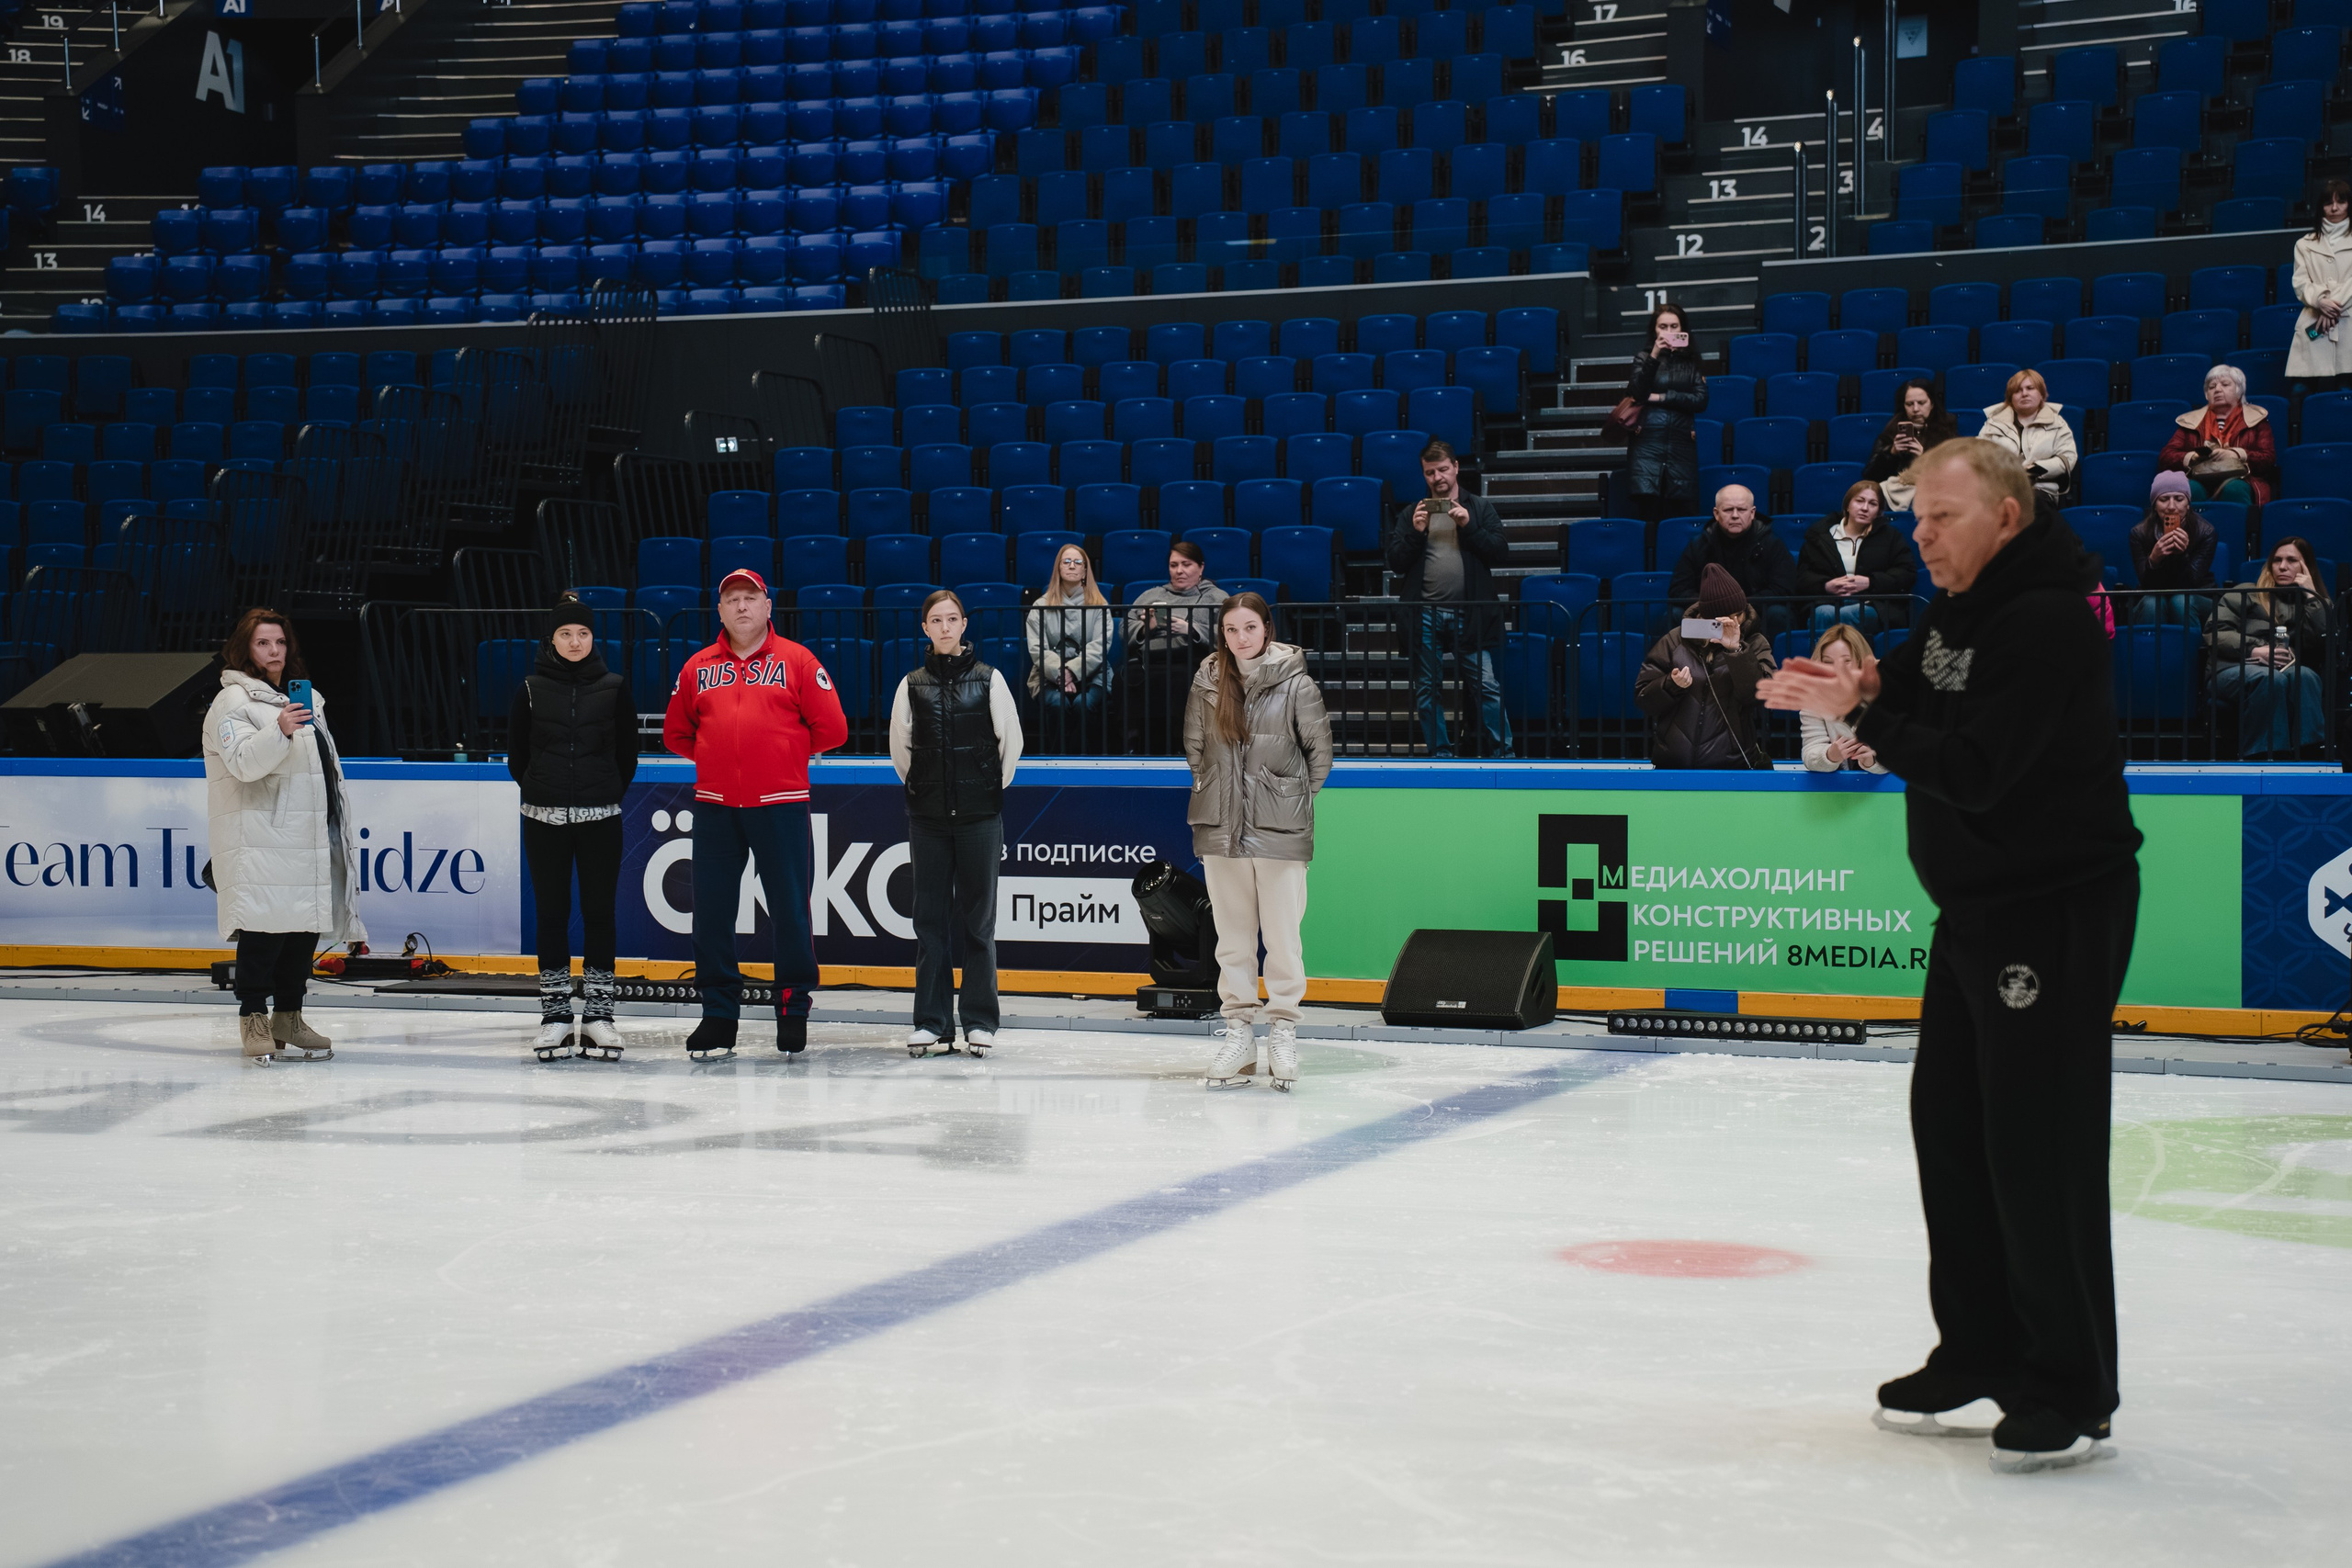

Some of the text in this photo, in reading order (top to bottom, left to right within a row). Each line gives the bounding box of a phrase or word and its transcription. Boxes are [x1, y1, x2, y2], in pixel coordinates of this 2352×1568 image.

[41, 15, 64, 28] 19
[1593, 4, 1619, 22] 17
[8, 49, 31, 62] 18
[1561, 49, 1587, 66] 16
[195, 29, 245, 115] A1
[1741, 126, 1770, 148] 14
[1709, 179, 1737, 200] 13
[84, 204, 106, 222] 14
[1676, 233, 1703, 256] 12
[34, 253, 58, 269] 13
[1645, 289, 1668, 312] 11
[0, 825, 138, 887] eam
[1017, 843, 1157, 866] подписке
[1602, 865, 1854, 896] МЕДИАХОЛДИНГ
[1012, 893, 1120, 930] Прайм
[1634, 904, 1912, 932] КОНСТРУКТИВНЫХ
[1634, 938, 1931, 971] РЕШЕНИЙ 8MEDIA.R
